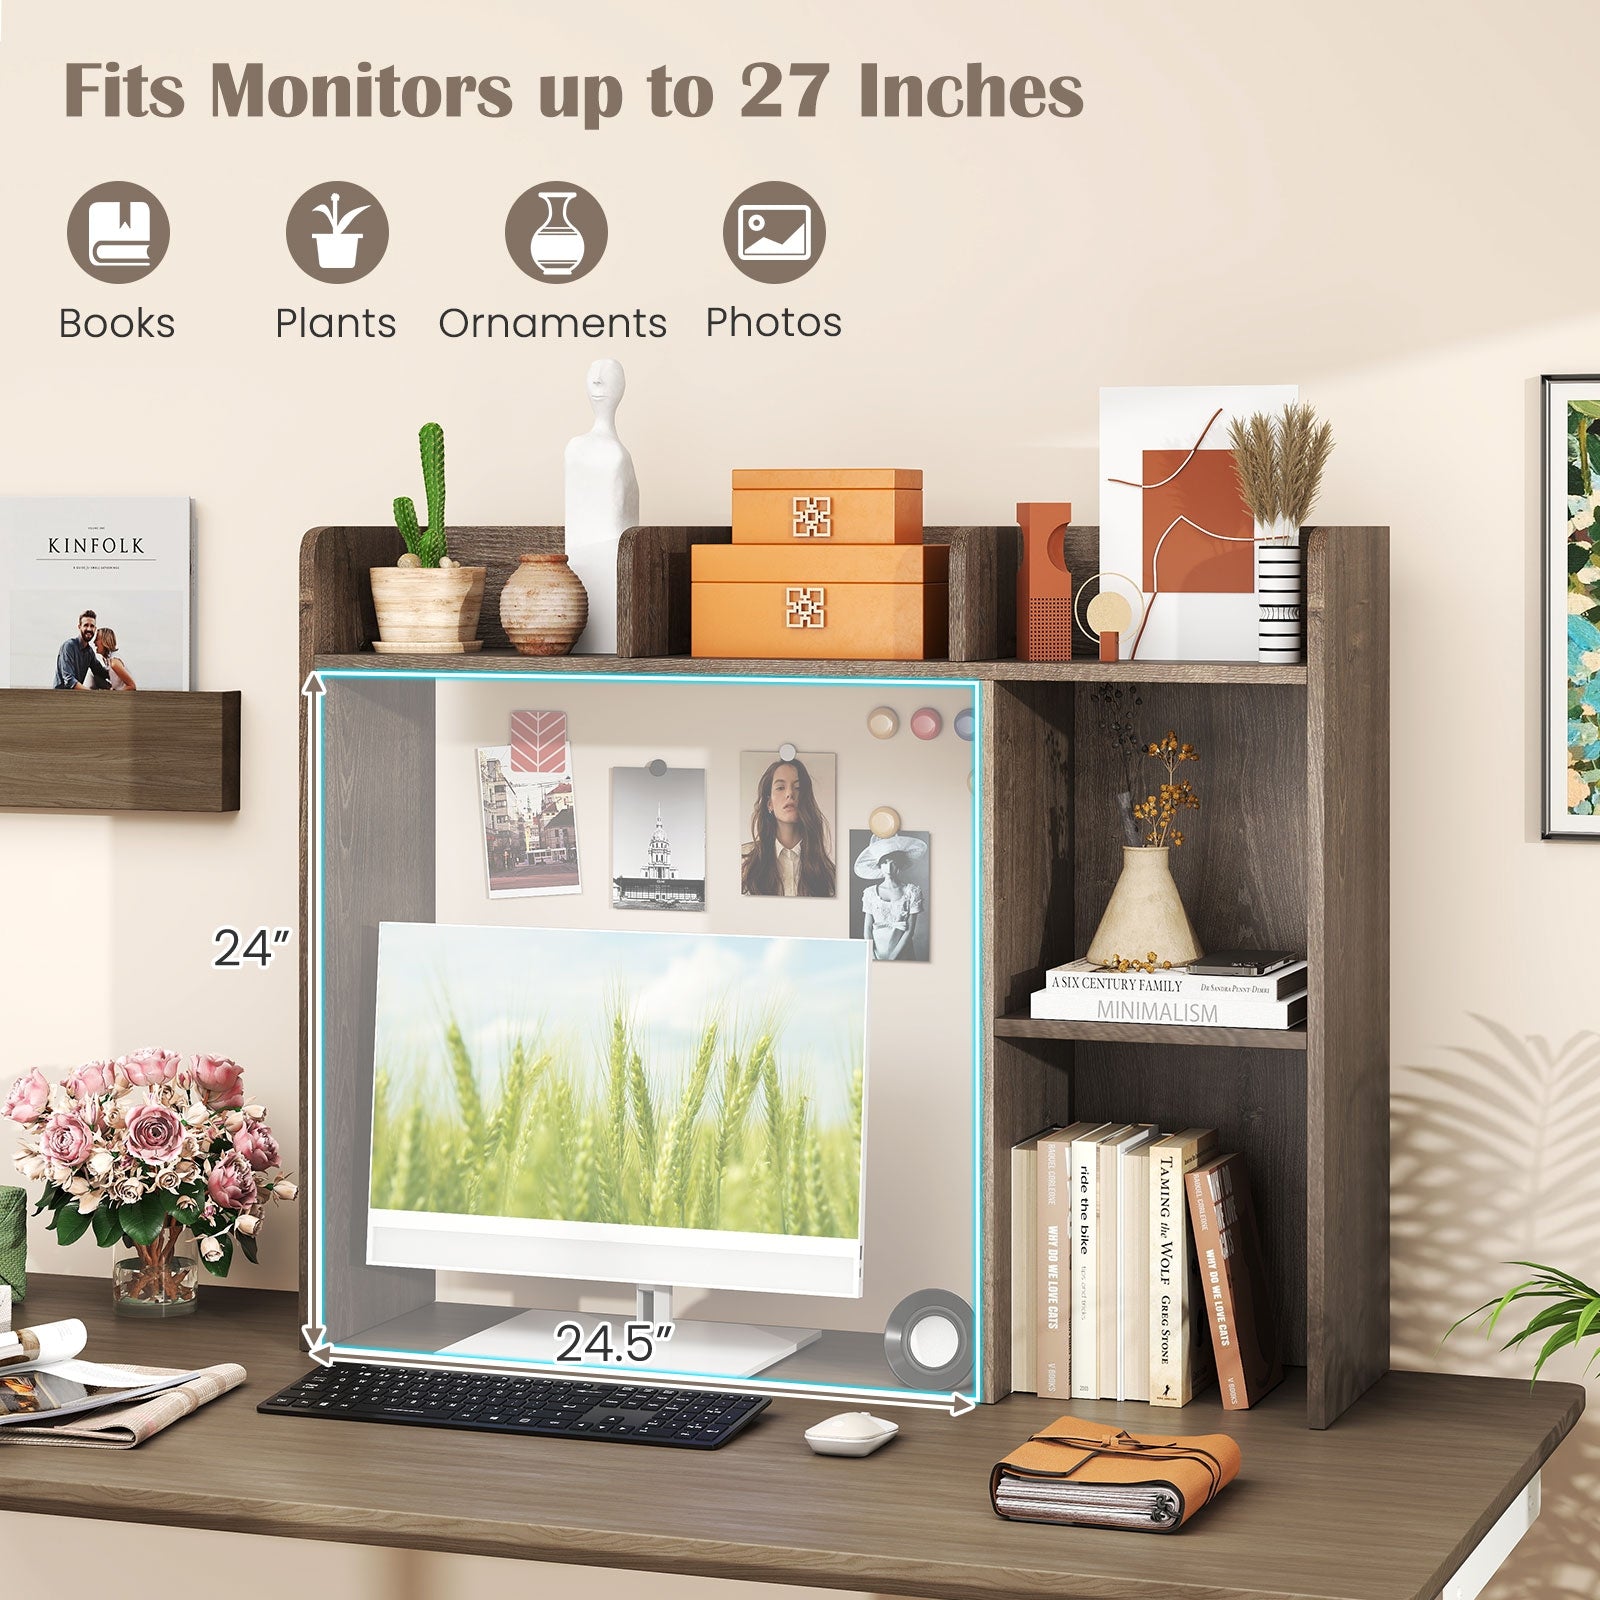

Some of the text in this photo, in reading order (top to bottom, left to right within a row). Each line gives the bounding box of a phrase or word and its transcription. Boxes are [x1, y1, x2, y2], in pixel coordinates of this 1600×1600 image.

[48, 537, 145, 554] KINFOLK
[1051, 976, 1183, 993] A SIX CENTURY FAMILY
[1096, 999, 1219, 1023] MINIMALISM
[1080, 1166, 1090, 1255] ride the bike
[1160, 1155, 1174, 1286] TAMING the WOLF
[1047, 1225, 1059, 1330] WHY DO WE LOVE CATS
[1205, 1248, 1231, 1347] WHY DO WE LOVE CATS
[1161, 1295, 1171, 1365] GREG STONE
